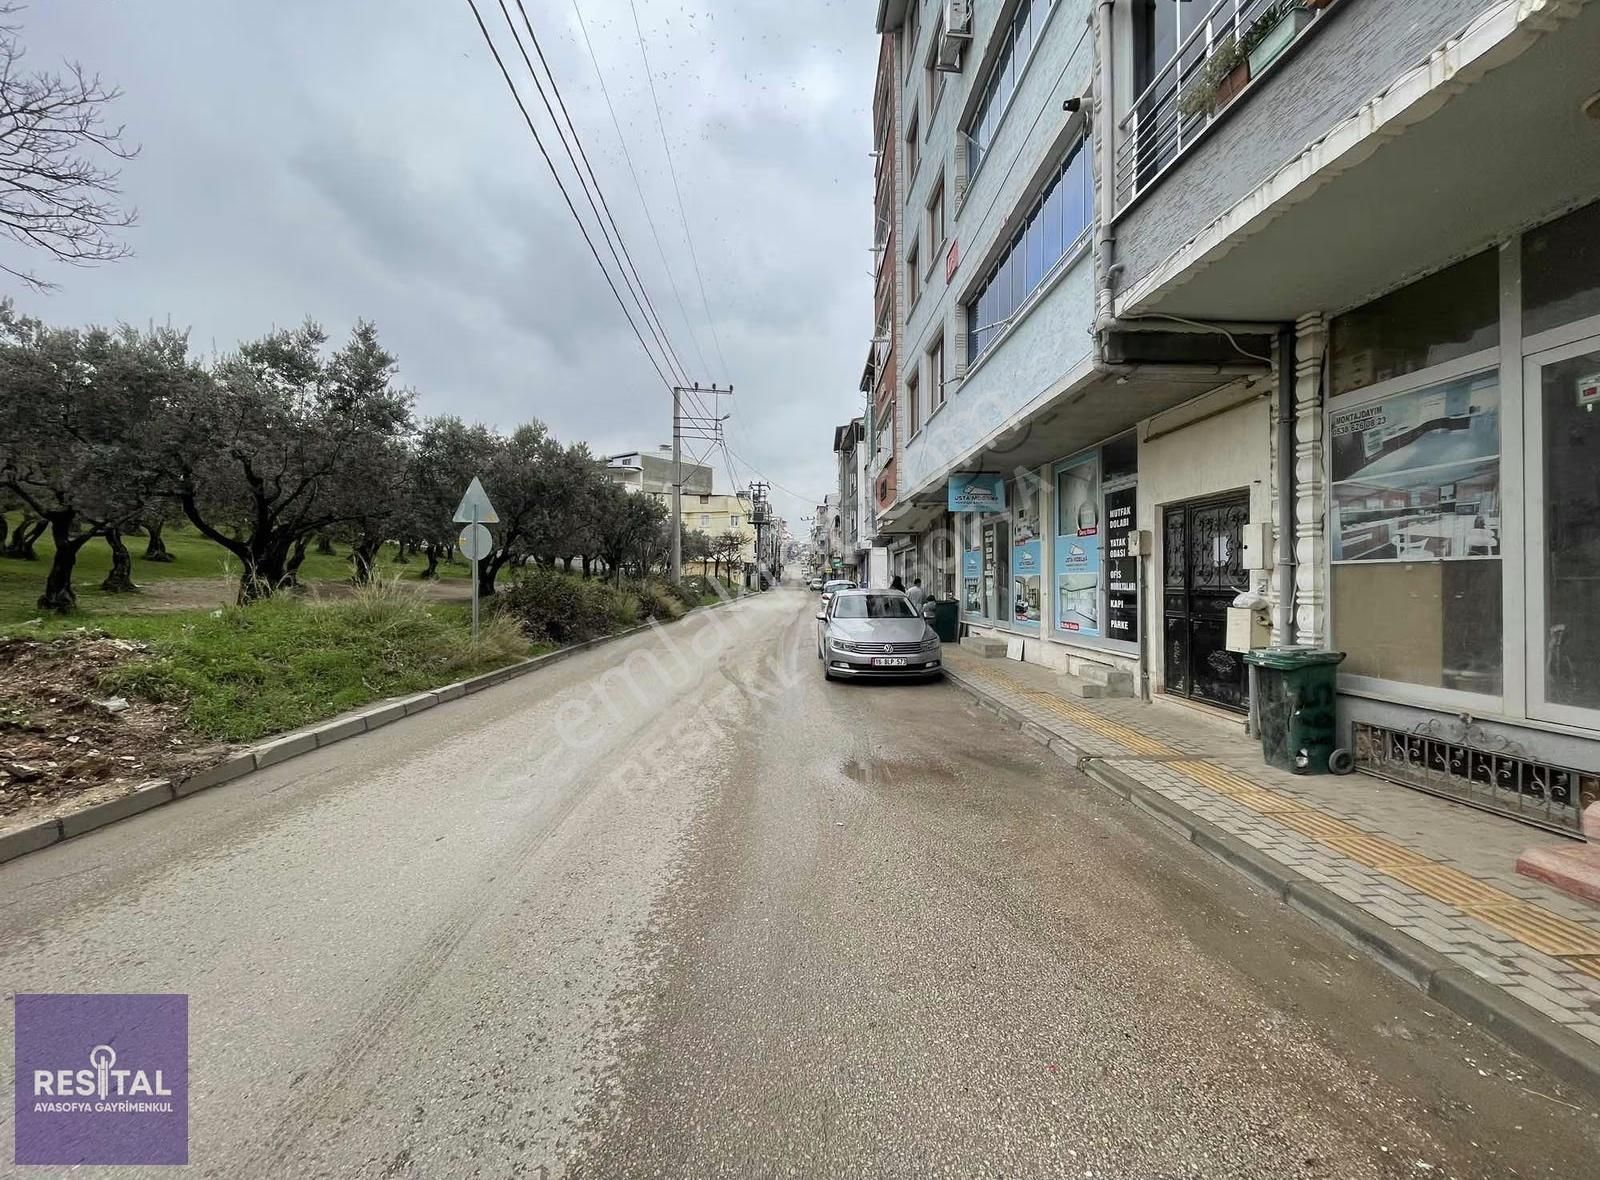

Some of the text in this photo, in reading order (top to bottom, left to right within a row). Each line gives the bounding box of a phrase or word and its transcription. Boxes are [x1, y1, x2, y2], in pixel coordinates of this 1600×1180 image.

[1110, 506, 1131, 518] MUTFAK
[1110, 518, 1129, 528] DOLABI
[1110, 538, 1126, 547] YATAK
[1110, 548, 1126, 558] ODASI
[1110, 600, 1124, 608] KAPI
[1110, 620, 1128, 630] PARKE
